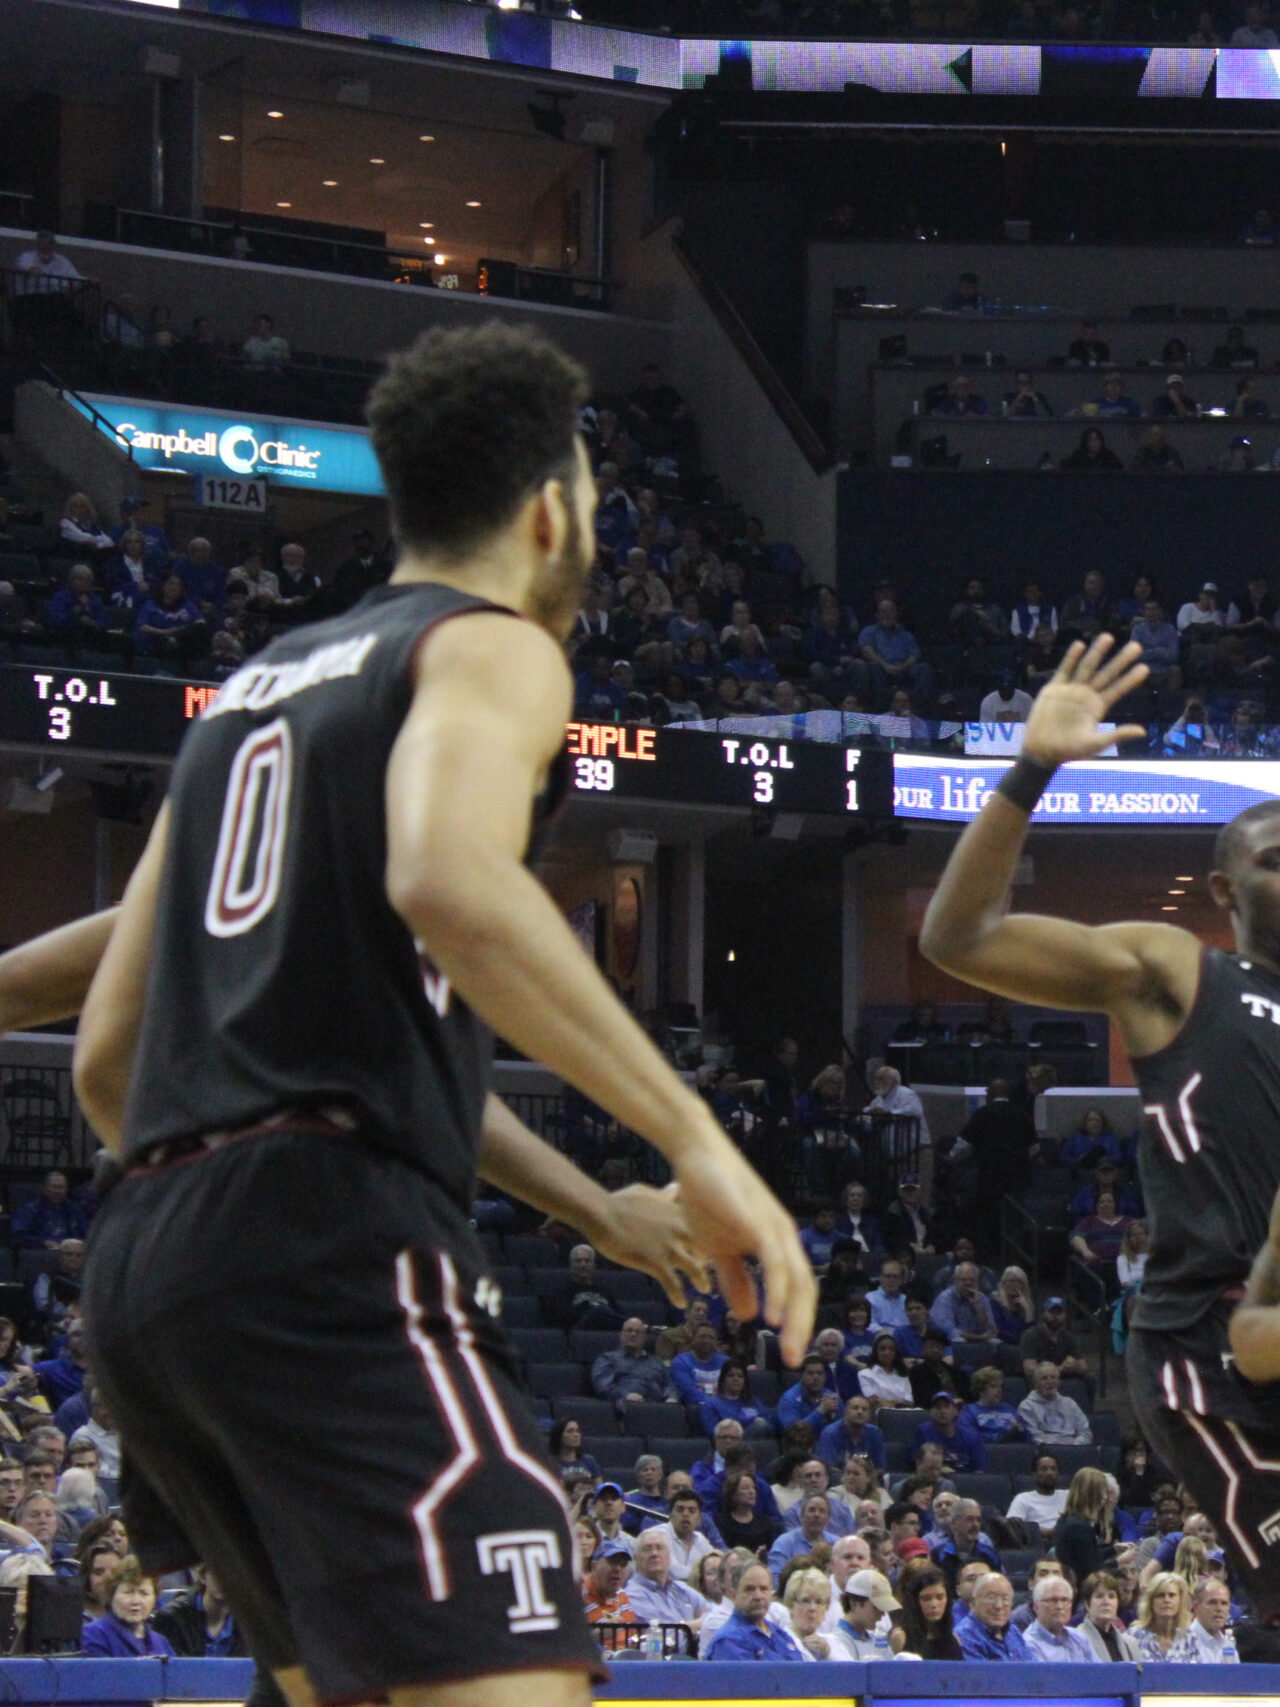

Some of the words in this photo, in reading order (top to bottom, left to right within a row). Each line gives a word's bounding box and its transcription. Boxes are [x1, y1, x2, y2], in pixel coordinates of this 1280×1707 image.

[115, 423, 217, 458] Campbell
[205, 479, 261, 507] 112A
[33, 674, 117, 706] T.O.L
[48, 706, 72, 740] 3
[565, 722, 657, 761] EMPLE
[722, 739, 794, 769] T.O.L
[574, 757, 614, 791] 39
[845, 749, 861, 772] F
[753, 771, 774, 803] 3
[845, 780, 859, 811] 1
[1088, 792, 1208, 814] PASSION.
[205, 717, 292, 938] 0
[476, 1531, 562, 1634] T
